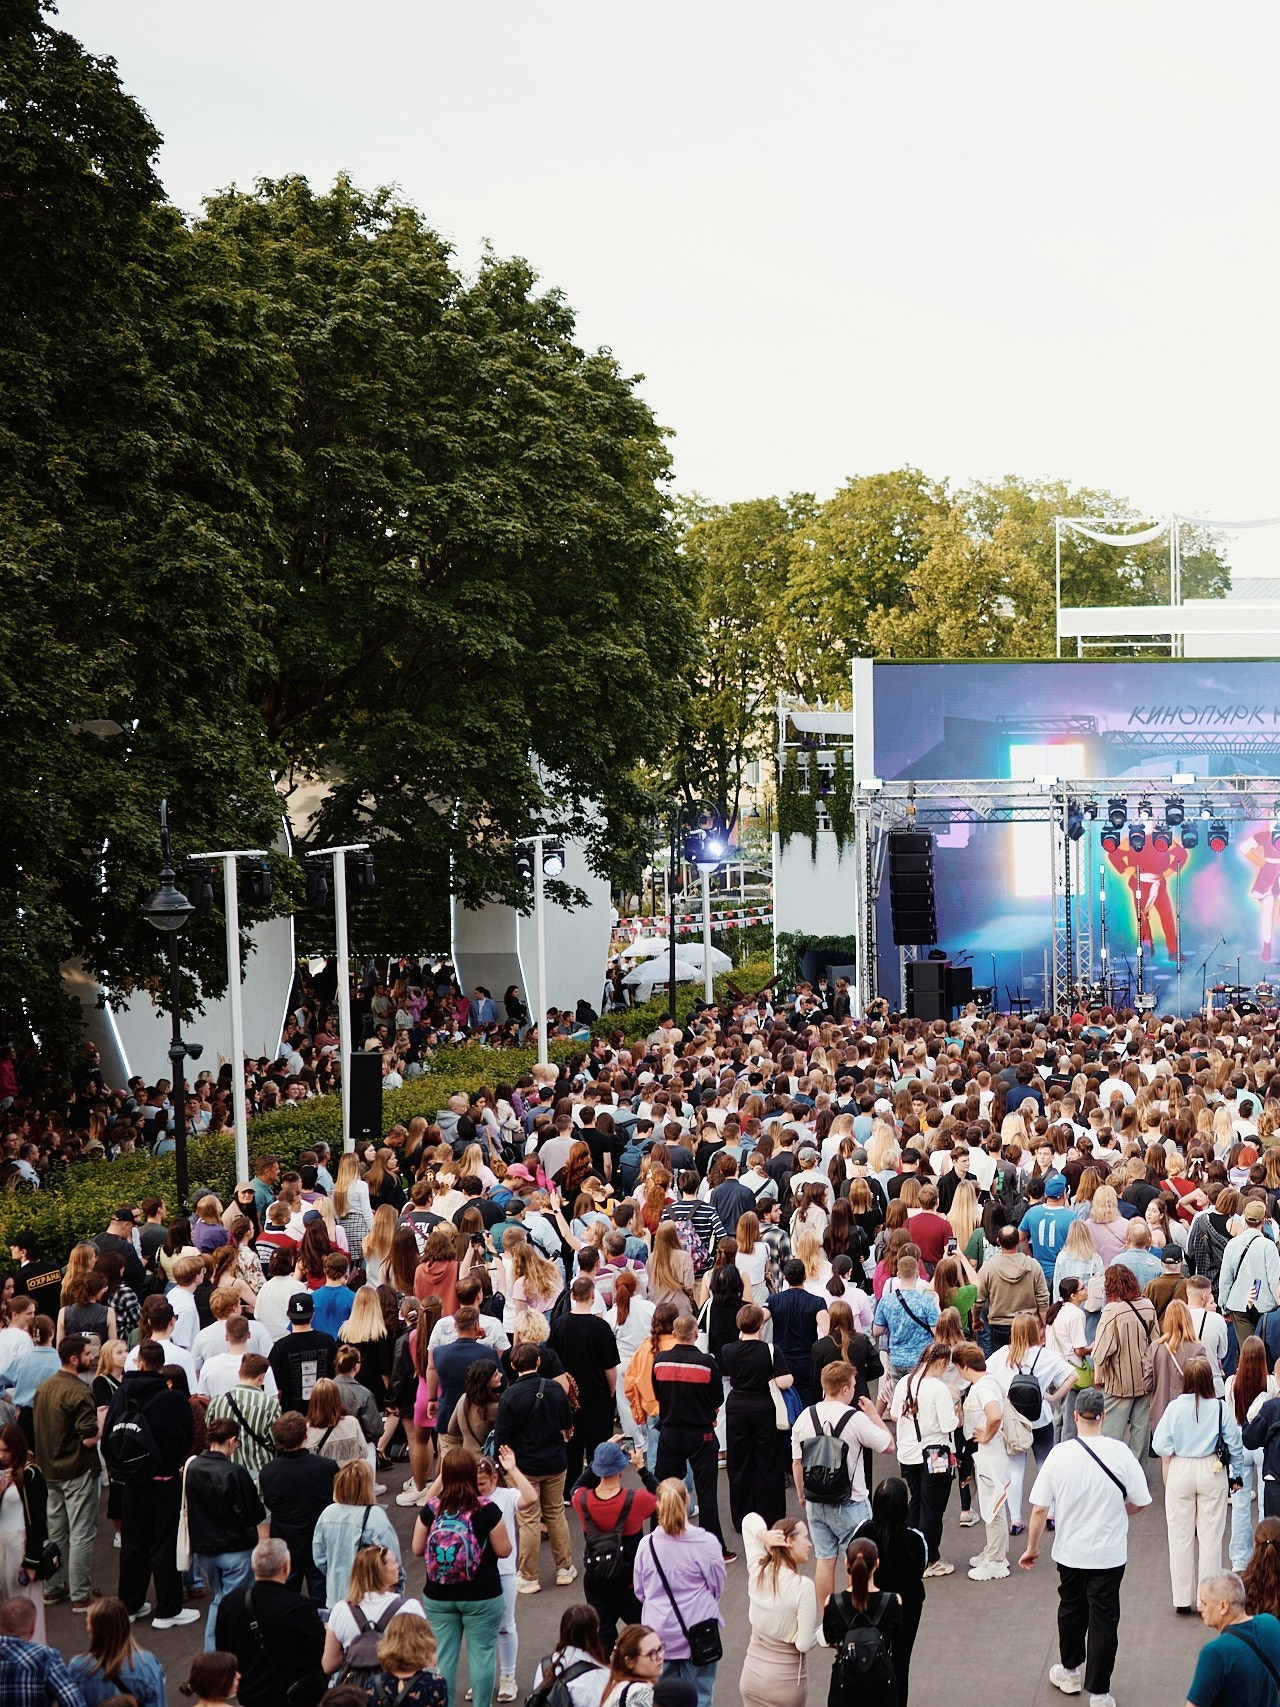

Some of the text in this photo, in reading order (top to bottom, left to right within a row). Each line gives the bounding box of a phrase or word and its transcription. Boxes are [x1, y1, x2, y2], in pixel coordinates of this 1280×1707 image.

[1127, 705, 1265, 725] КИНОПАРК
[1038, 1218, 1056, 1247] 11
[29, 1272, 60, 1287] ОХРАНА
